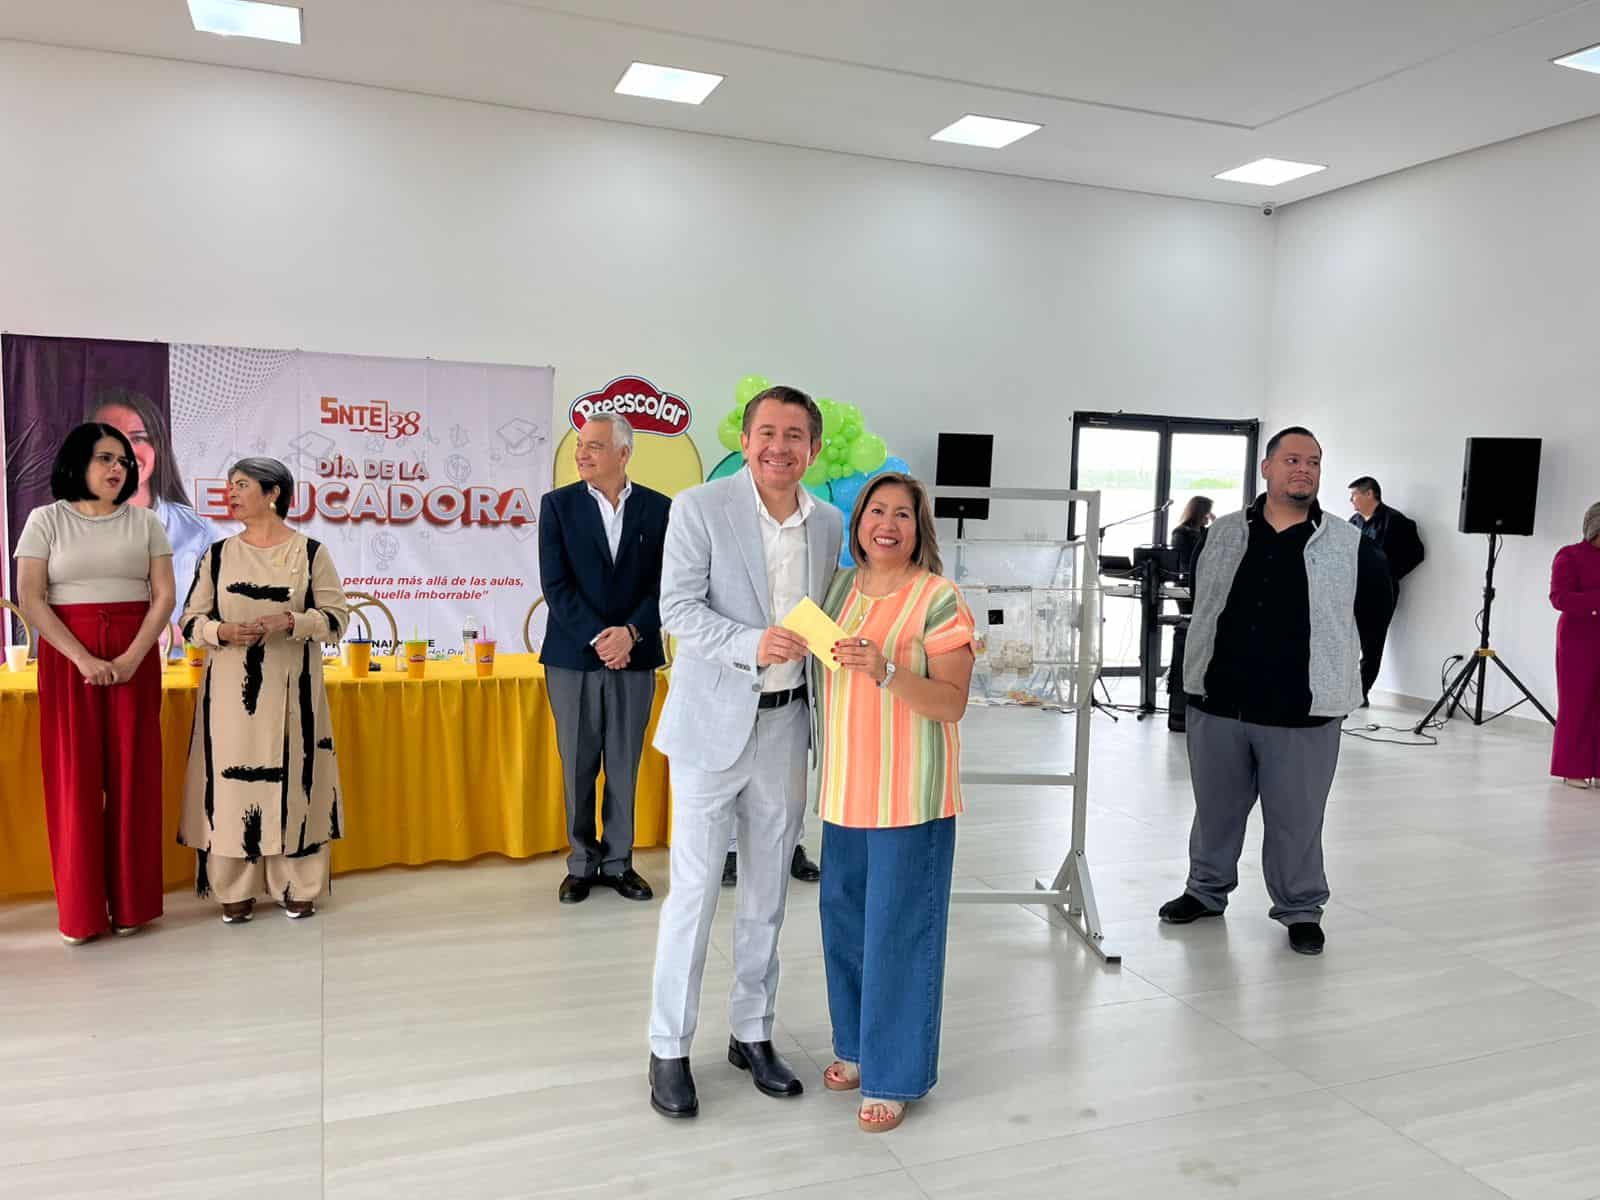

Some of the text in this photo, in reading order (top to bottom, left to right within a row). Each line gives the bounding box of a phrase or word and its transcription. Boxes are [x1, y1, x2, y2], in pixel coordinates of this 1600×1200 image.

[320, 396, 421, 440] SNTE 38
[575, 393, 686, 426] Preescolar
[364, 459, 395, 480] DE
[399, 460, 429, 482] LA
[195, 478, 537, 526] EUCADORA
[343, 576, 524, 587] perdura más allá de las aulas,
[374, 590, 411, 600] huella
